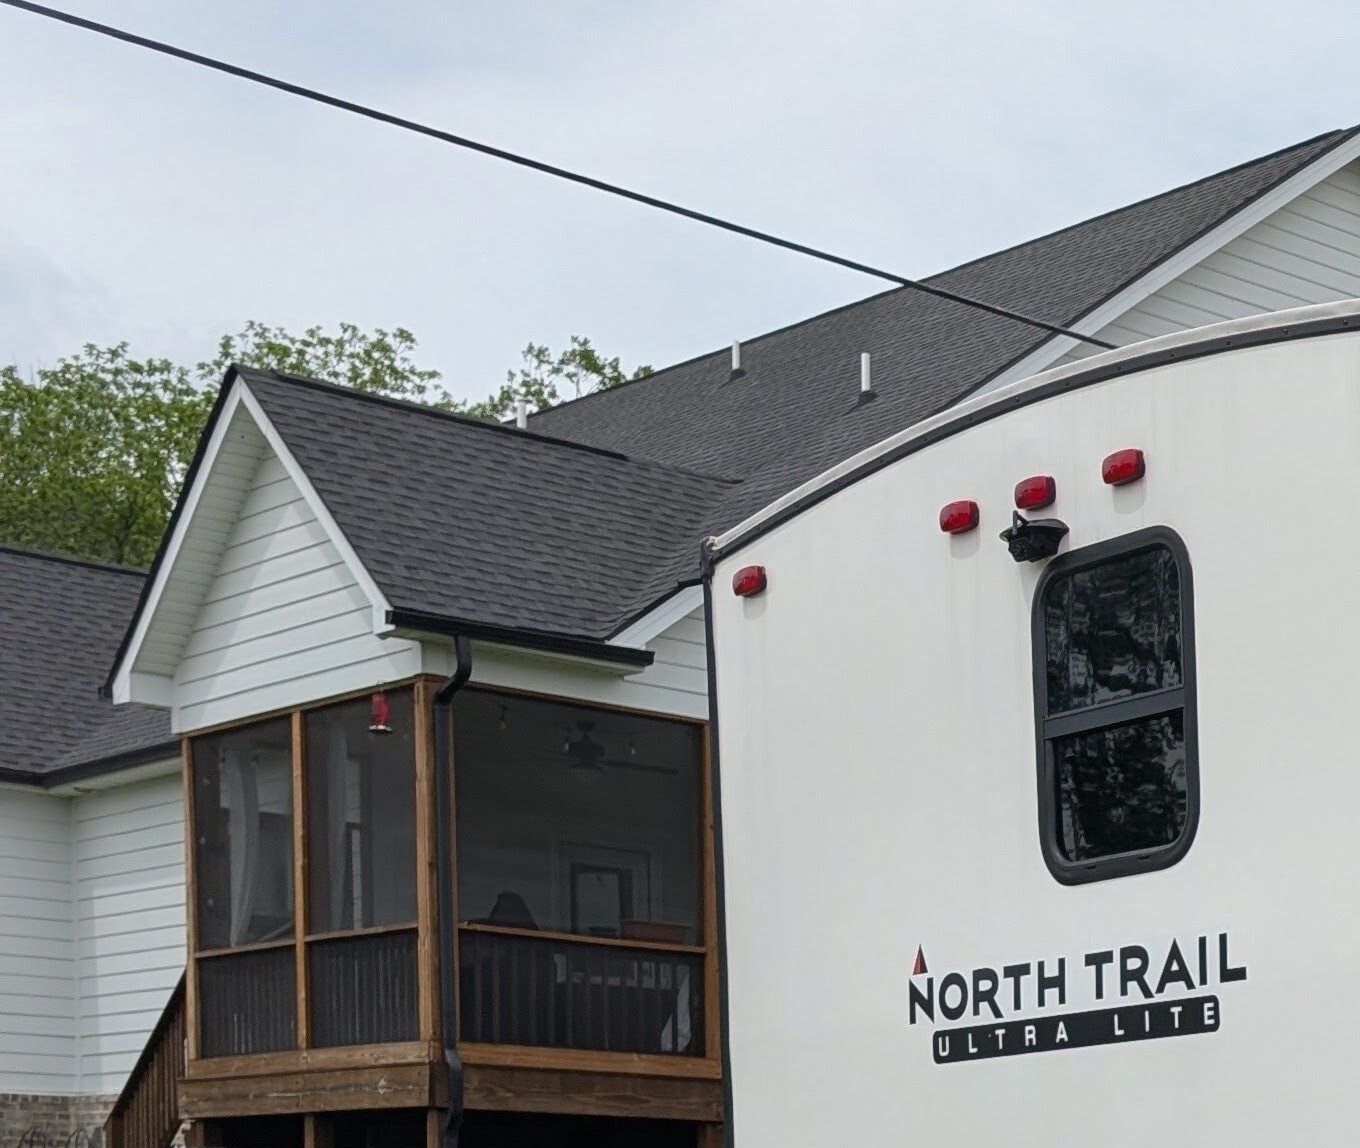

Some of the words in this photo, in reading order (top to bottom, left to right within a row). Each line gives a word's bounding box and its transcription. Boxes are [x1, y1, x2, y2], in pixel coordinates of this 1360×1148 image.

[908, 956, 1067, 1025] NORTH
[1084, 932, 1247, 1000] TRAIL
[938, 1020, 1069, 1057] ULTRA
[1113, 1002, 1215, 1036] LITE
